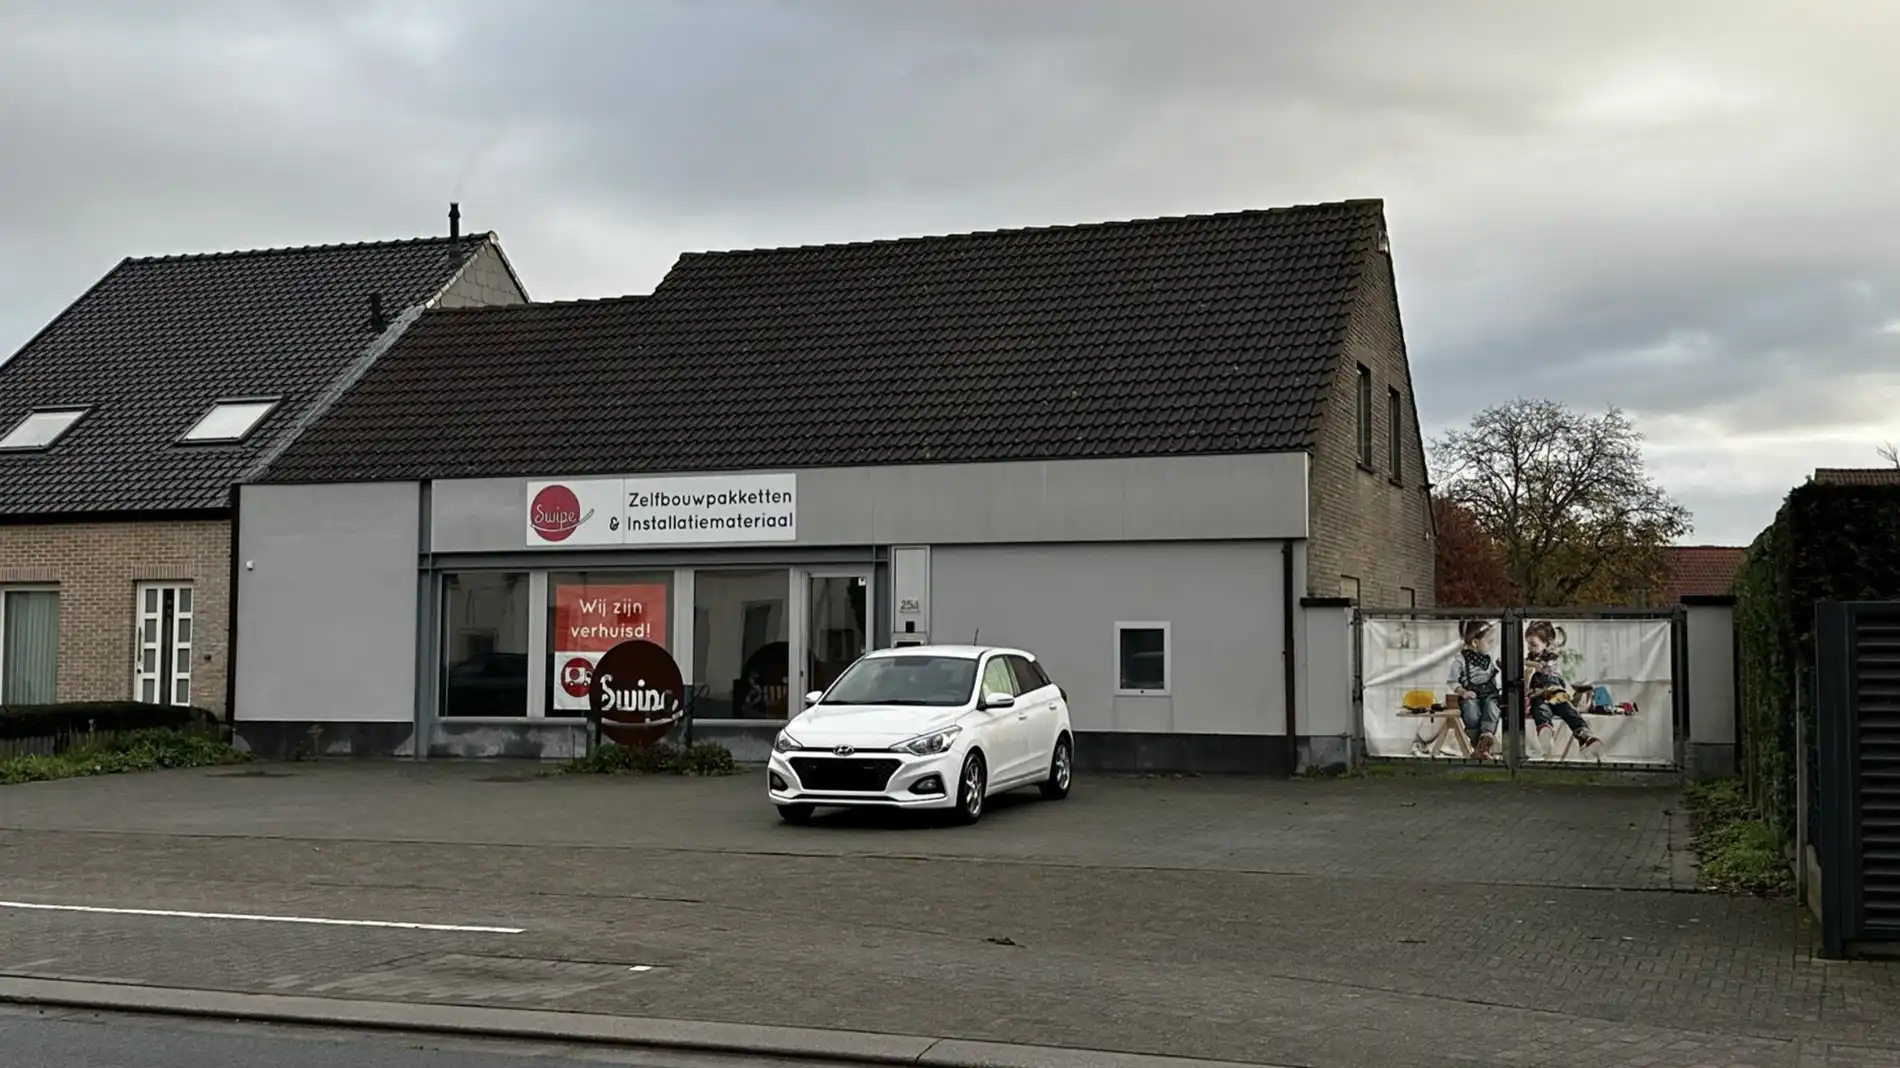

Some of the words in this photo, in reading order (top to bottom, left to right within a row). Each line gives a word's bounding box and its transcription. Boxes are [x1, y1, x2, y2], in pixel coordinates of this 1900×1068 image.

[628, 489, 792, 508] Zelfbouwpakketten
[534, 503, 577, 531] Swipe
[609, 516, 620, 531] &
[627, 512, 793, 531] Installatiemateriaal
[579, 598, 607, 617] Wij
[613, 598, 642, 617] zijn
[571, 623, 651, 638] verhuisd!
